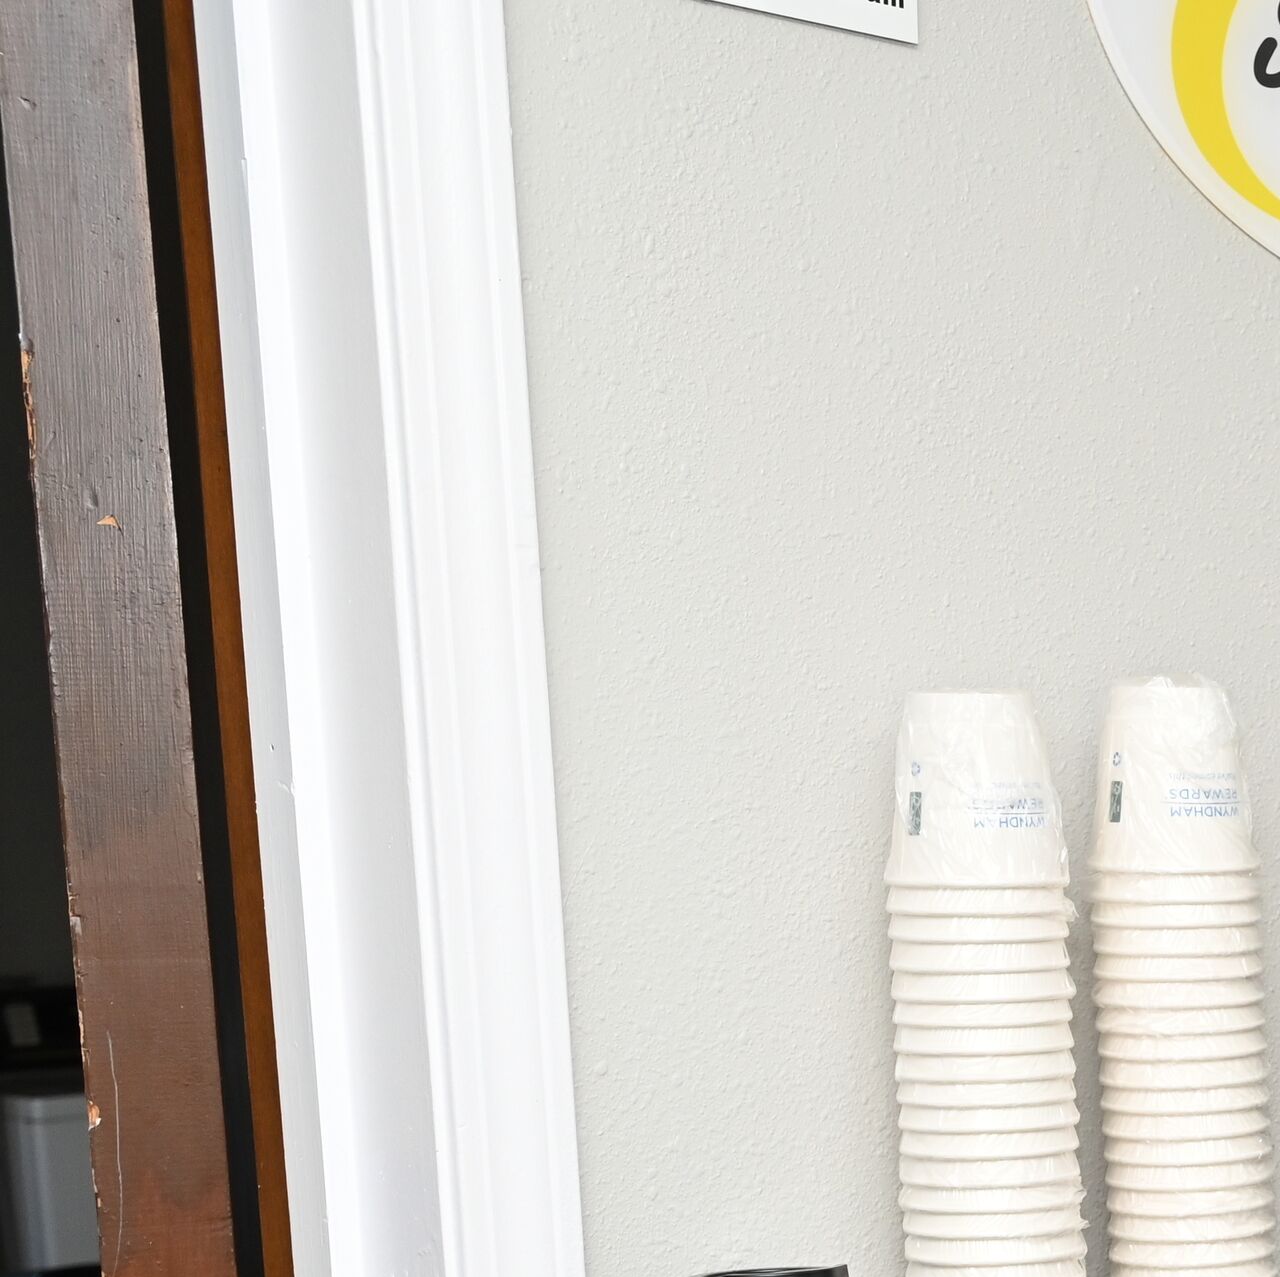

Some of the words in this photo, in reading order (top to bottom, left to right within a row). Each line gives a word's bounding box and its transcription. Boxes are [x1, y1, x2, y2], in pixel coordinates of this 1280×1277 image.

[1169, 788, 1237, 800] REWARDS
[1170, 806, 1239, 817] WYNDHAM
[973, 816, 1045, 828] WYNDHAM
